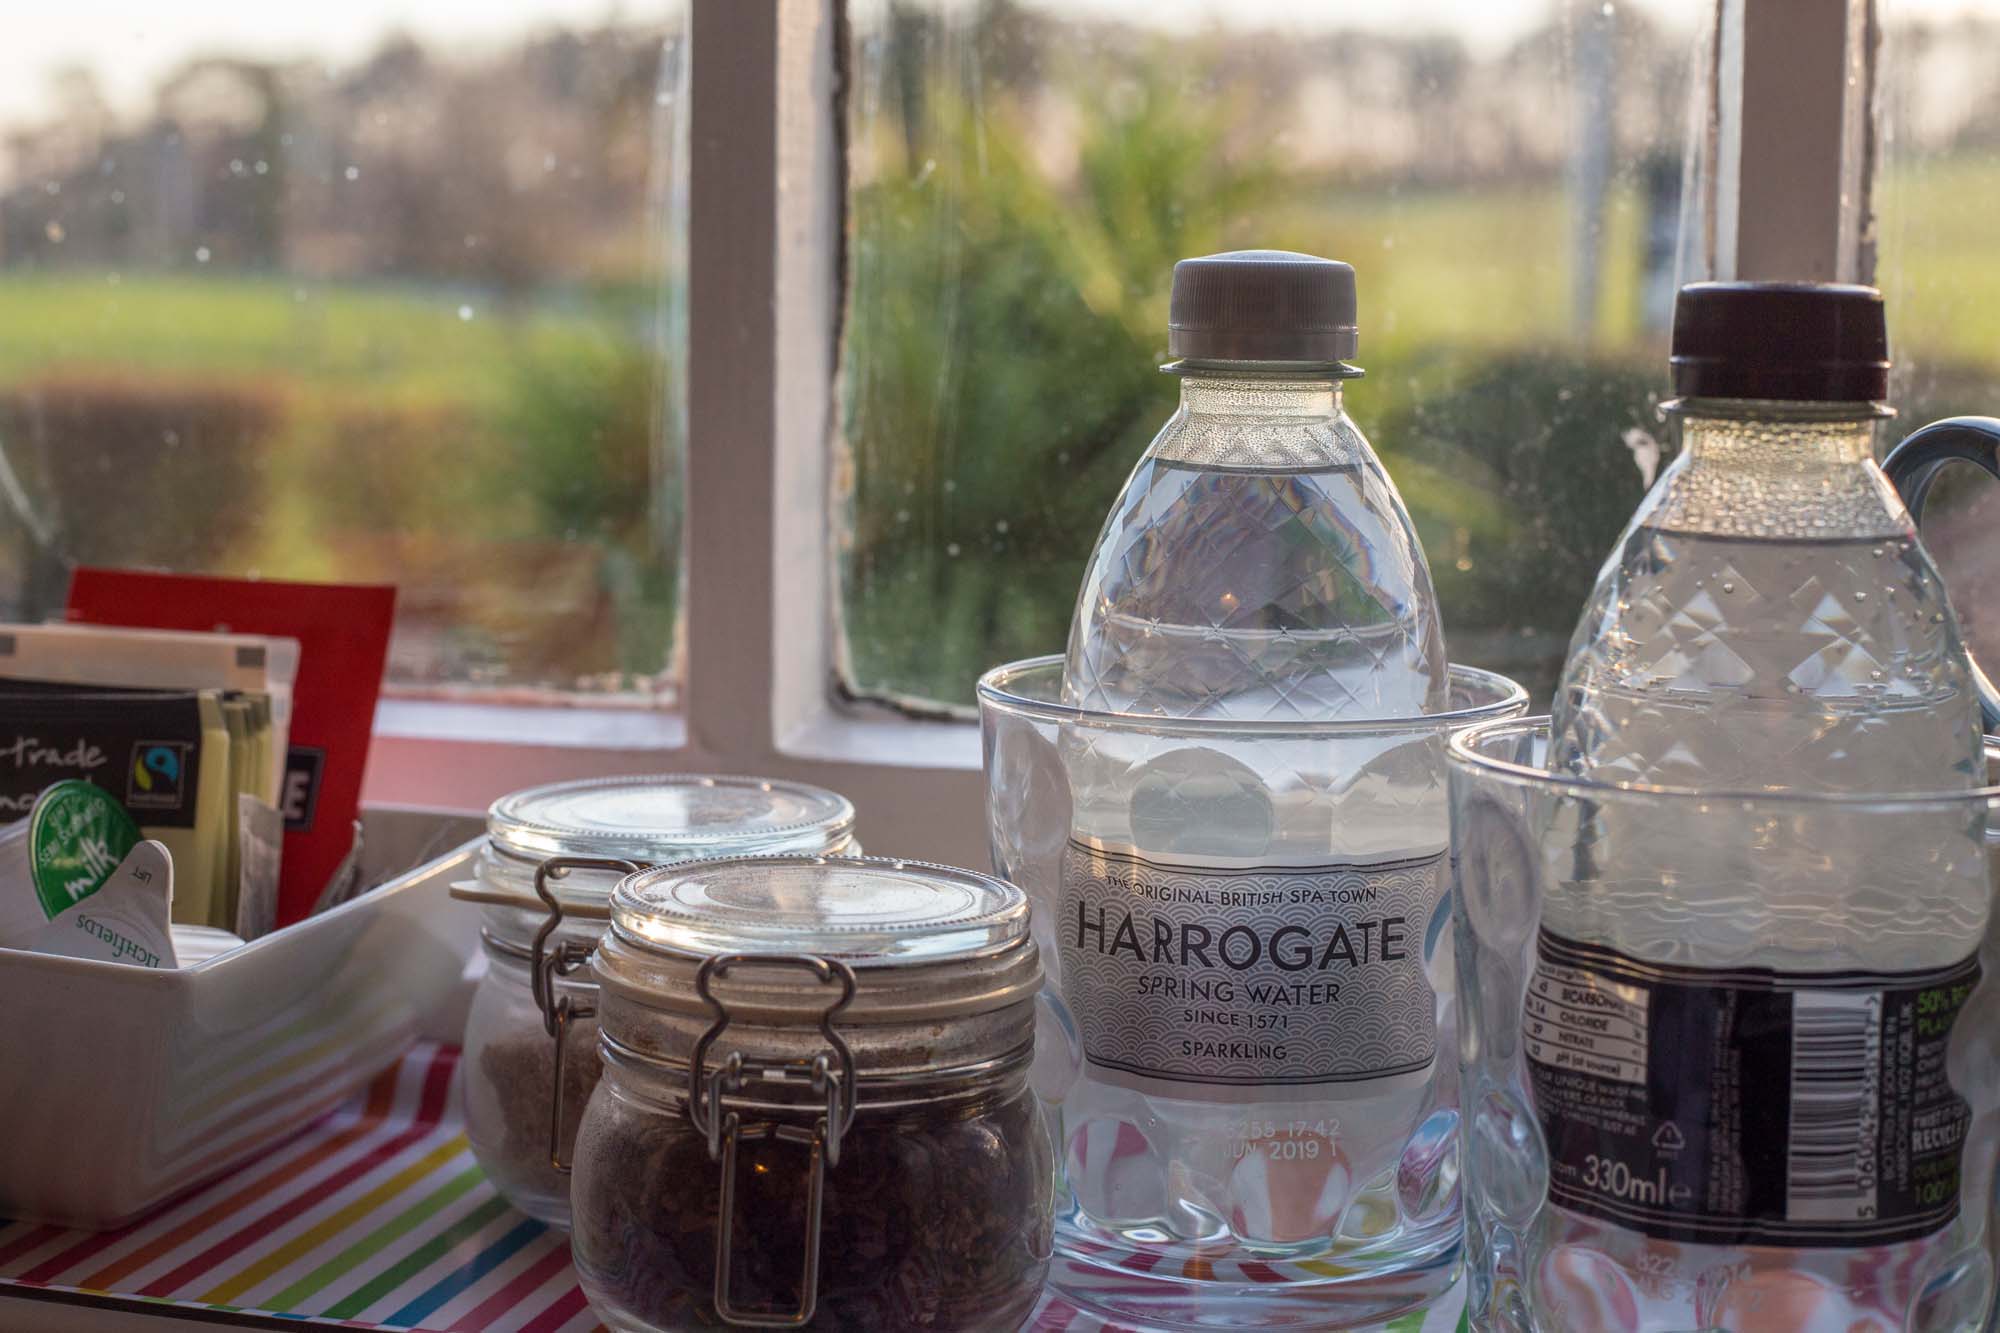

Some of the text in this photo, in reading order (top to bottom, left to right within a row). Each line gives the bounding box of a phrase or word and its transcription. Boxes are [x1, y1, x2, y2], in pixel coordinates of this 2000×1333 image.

[65, 836, 119, 901] milk
[1106, 876, 1377, 907] THE ORIGINAL BRITISH SPA TOWN
[1077, 901, 1406, 972] HARROGATE
[1137, 976, 1341, 1006] SPRING WATER
[1183, 1009, 1289, 1029] SINCE 1571
[1182, 1040, 1287, 1061] SPARKLING
[1269, 1140, 1320, 1161] 2019
